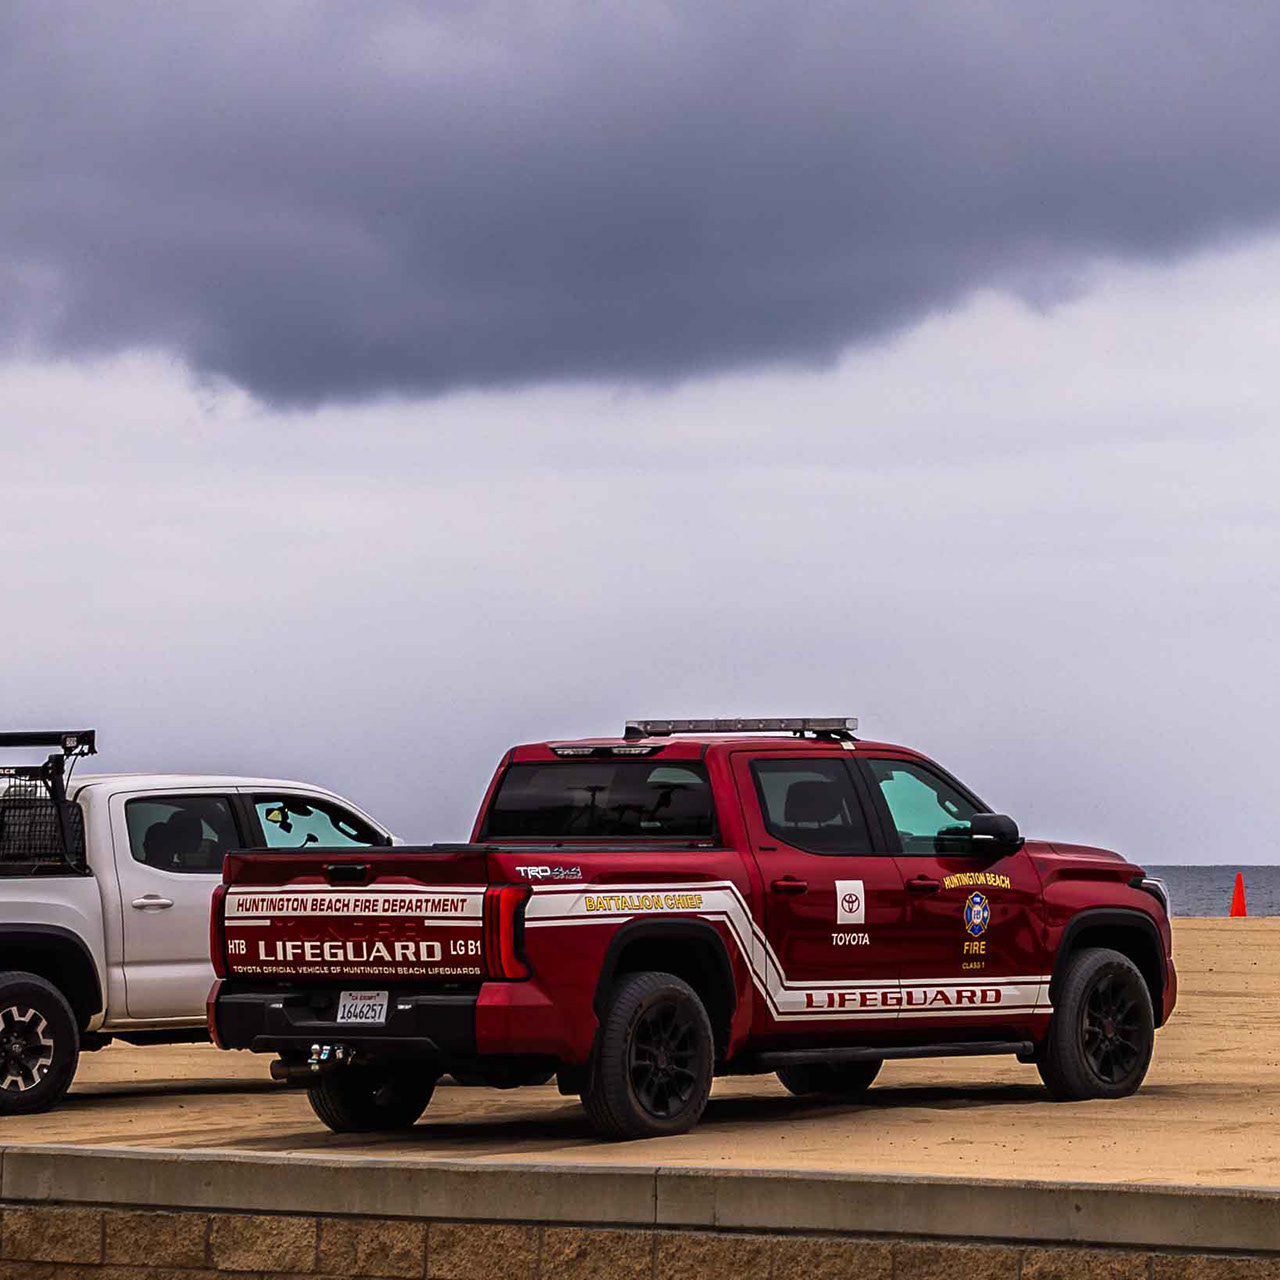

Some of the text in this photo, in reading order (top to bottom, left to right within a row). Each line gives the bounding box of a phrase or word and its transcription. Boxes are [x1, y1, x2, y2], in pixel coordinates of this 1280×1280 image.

[515, 866, 551, 880] TRD
[943, 872, 1011, 889] HUNTINGTON BEACH
[236, 898, 467, 913] HUNTINGTON BEACH FIRE DEPARTMENT
[585, 894, 703, 911] BATTALION CHIEF
[228, 939, 247, 954] HTB
[831, 933, 870, 946] TOYOTA
[258, 940, 442, 961] LIFEGUARD
[450, 940, 481, 955] LG B1
[963, 941, 987, 954] FIRE
[263, 966, 296, 974] OFFICIAL
[297, 966, 329, 974] VEHICLE
[330, 966, 341, 974] OF
[343, 966, 395, 974] HUNTINGTON
[397, 967, 426, 975] BEACH
[428, 967, 481, 975] LIFEGUARDS
[805, 988, 1002, 1009] LIFEGUARD
[340, 1003, 384, 1020] 1646257
